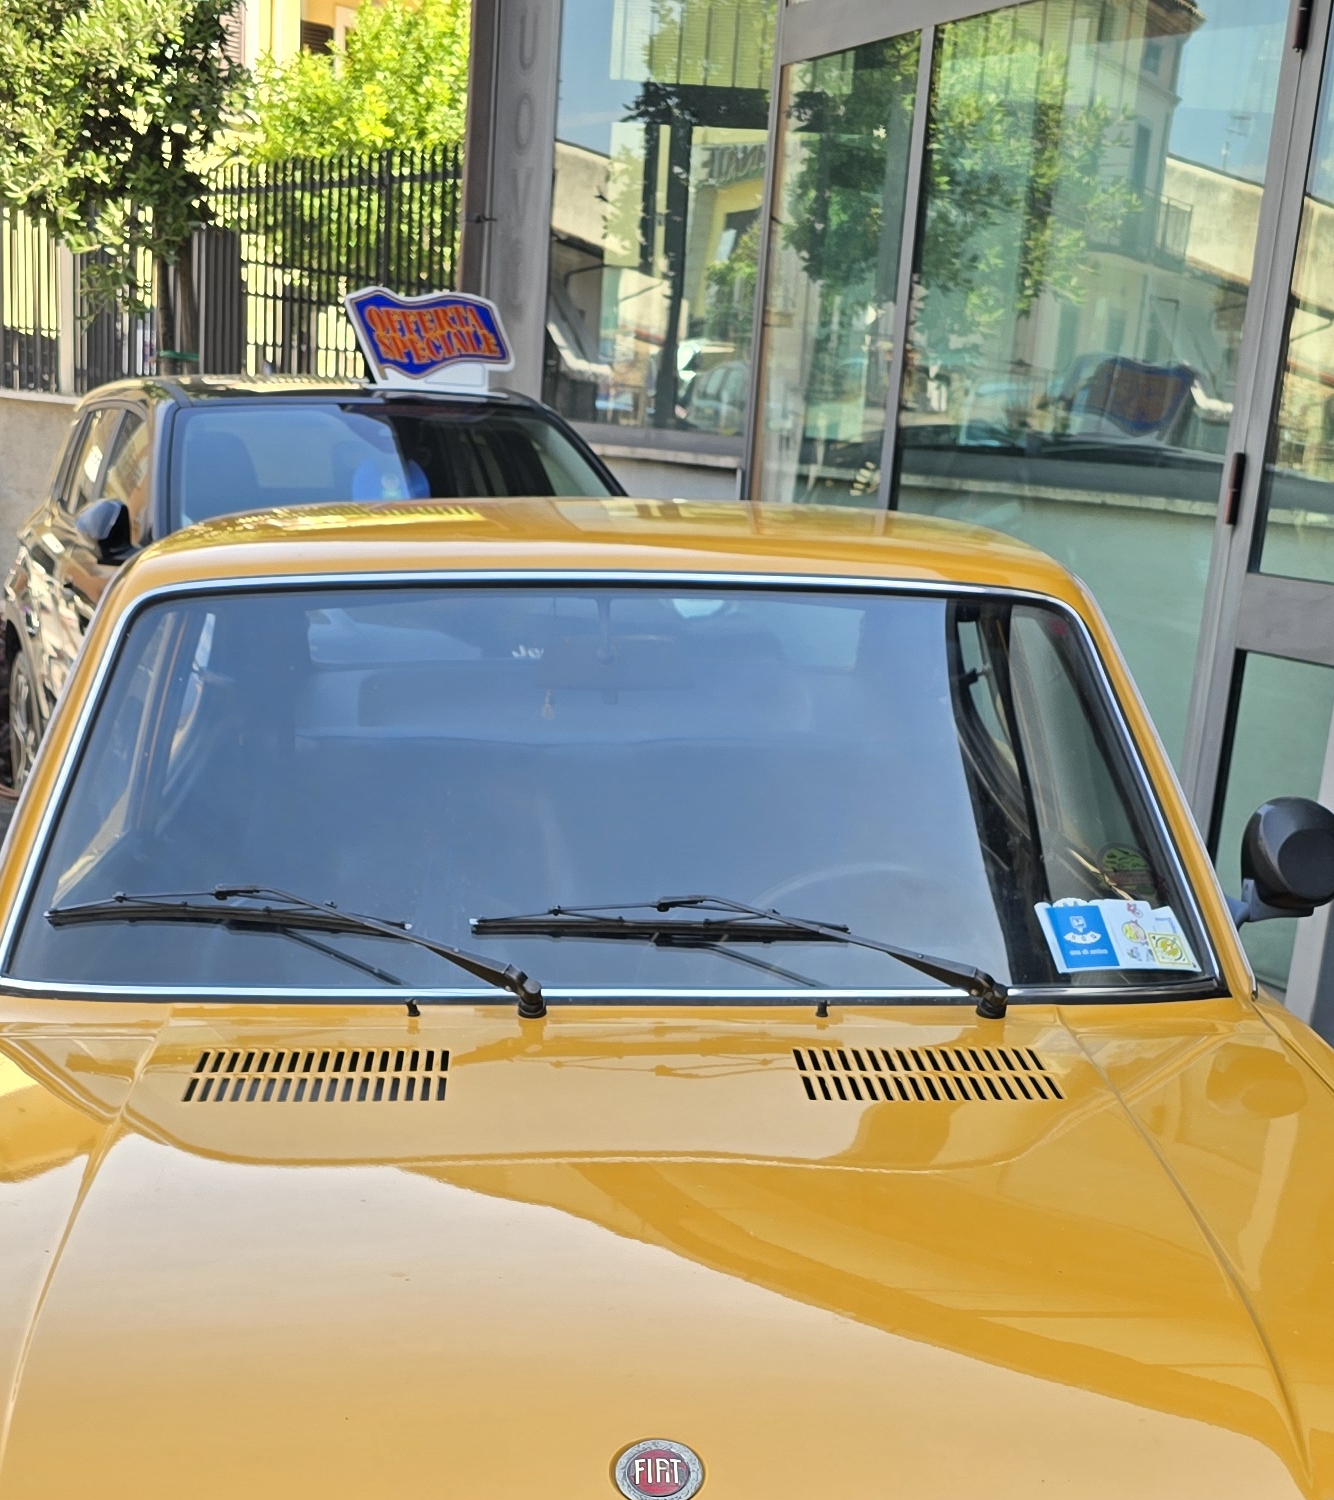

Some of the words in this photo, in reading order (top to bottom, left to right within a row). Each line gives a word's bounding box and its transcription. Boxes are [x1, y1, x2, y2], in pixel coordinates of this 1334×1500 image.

[365, 304, 486, 338] OFFERTA
[374, 330, 503, 364] SPECIALE
[634, 1458, 682, 1485] FIAT
